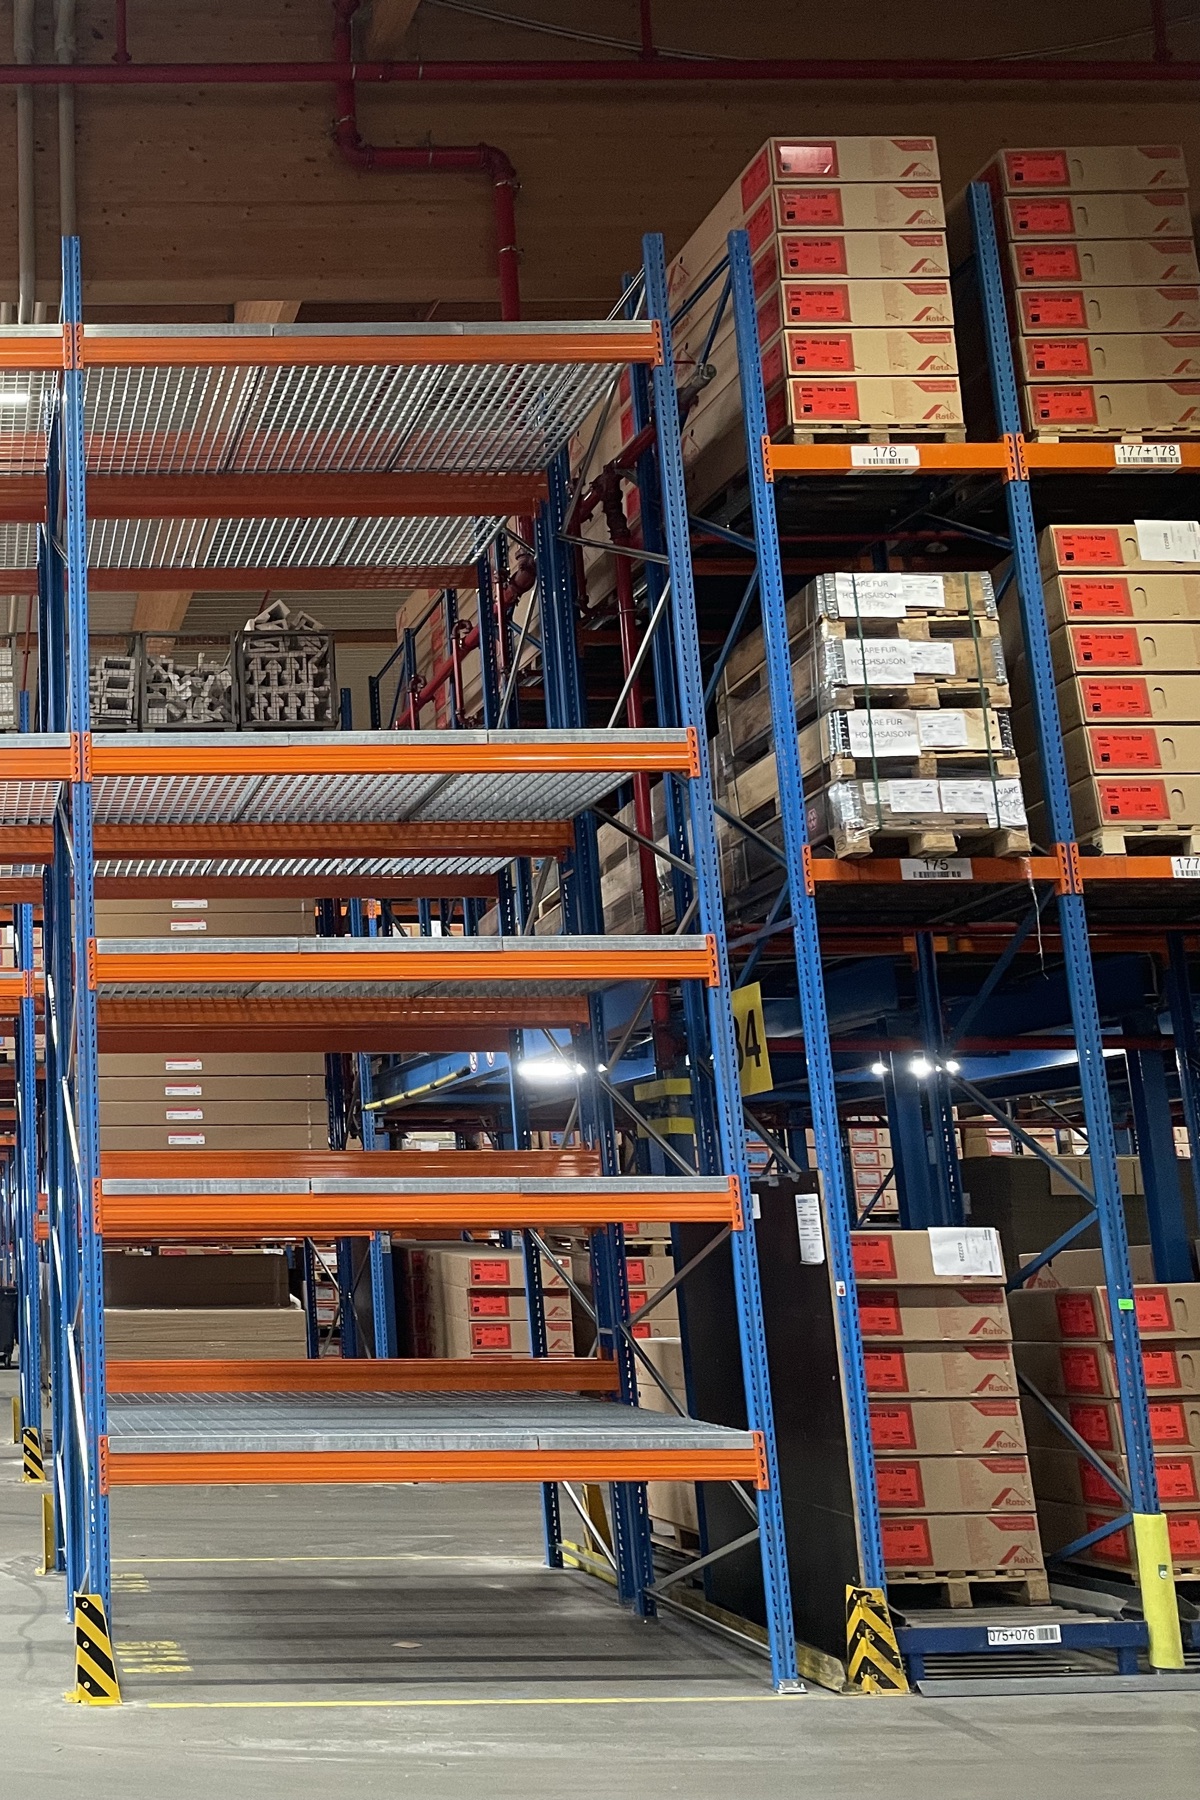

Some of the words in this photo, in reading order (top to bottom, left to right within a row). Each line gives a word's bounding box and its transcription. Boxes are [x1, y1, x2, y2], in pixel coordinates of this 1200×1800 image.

[873, 446, 897, 458] 176
[1120, 445, 1177, 457] 177+178
[922, 859, 949, 871] 175
[996, 1440, 1017, 1448] Roto
[1005, 1498, 1026, 1506] Roto
[989, 1629, 1035, 1642] 075+076
